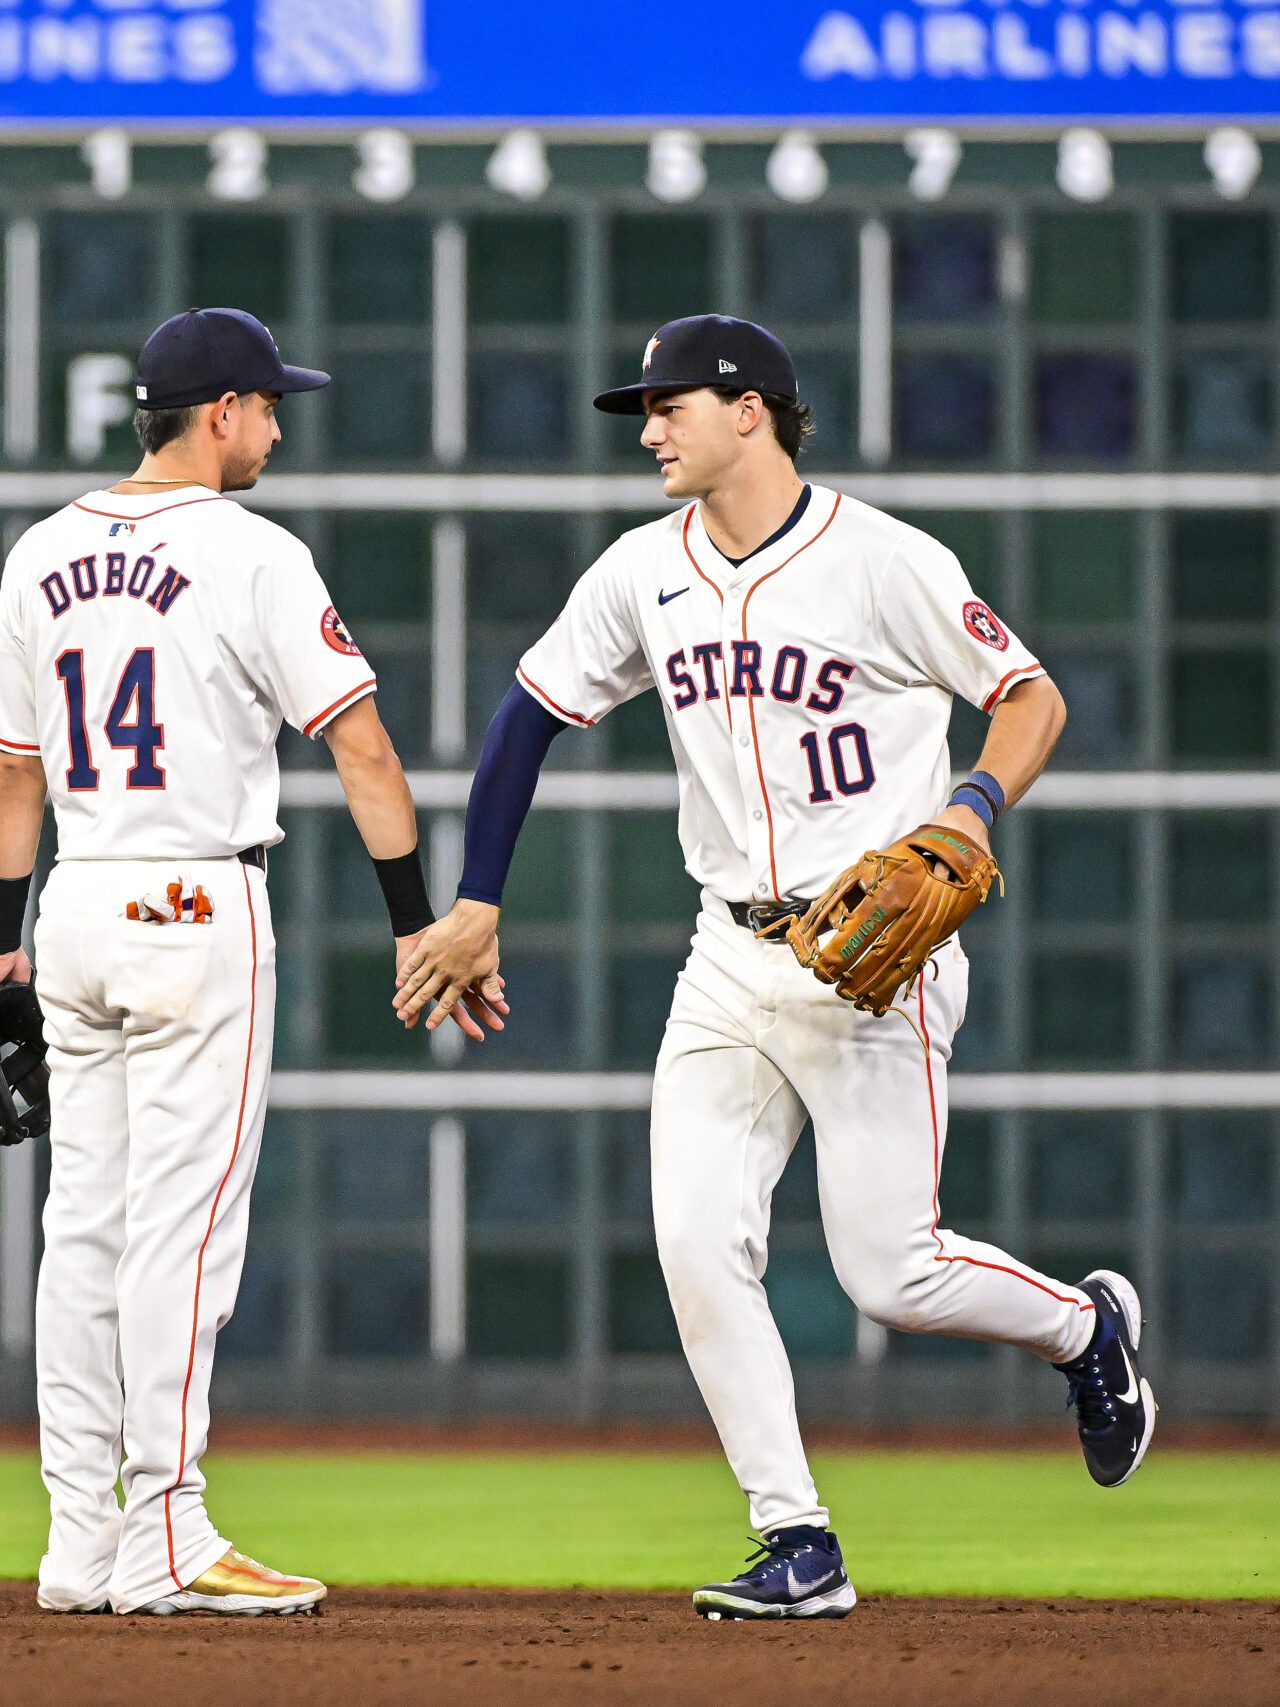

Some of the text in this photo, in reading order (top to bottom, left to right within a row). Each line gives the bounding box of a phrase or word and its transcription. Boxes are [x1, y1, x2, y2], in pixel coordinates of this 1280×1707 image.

[82, 129, 132, 201] 1
[206, 129, 270, 202] 2
[353, 129, 415, 203] 3
[485, 129, 550, 200] 4
[646, 129, 706, 203] 5
[766, 129, 829, 204] 6
[906, 129, 962, 201] 7
[1056, 128, 1114, 202] 8
[1203, 128, 1262, 200] 9
[39, 542, 191, 620] DUBÓN
[666, 638, 856, 715] STROS
[54, 646, 167, 793] 14
[799, 721, 878, 805] 10
